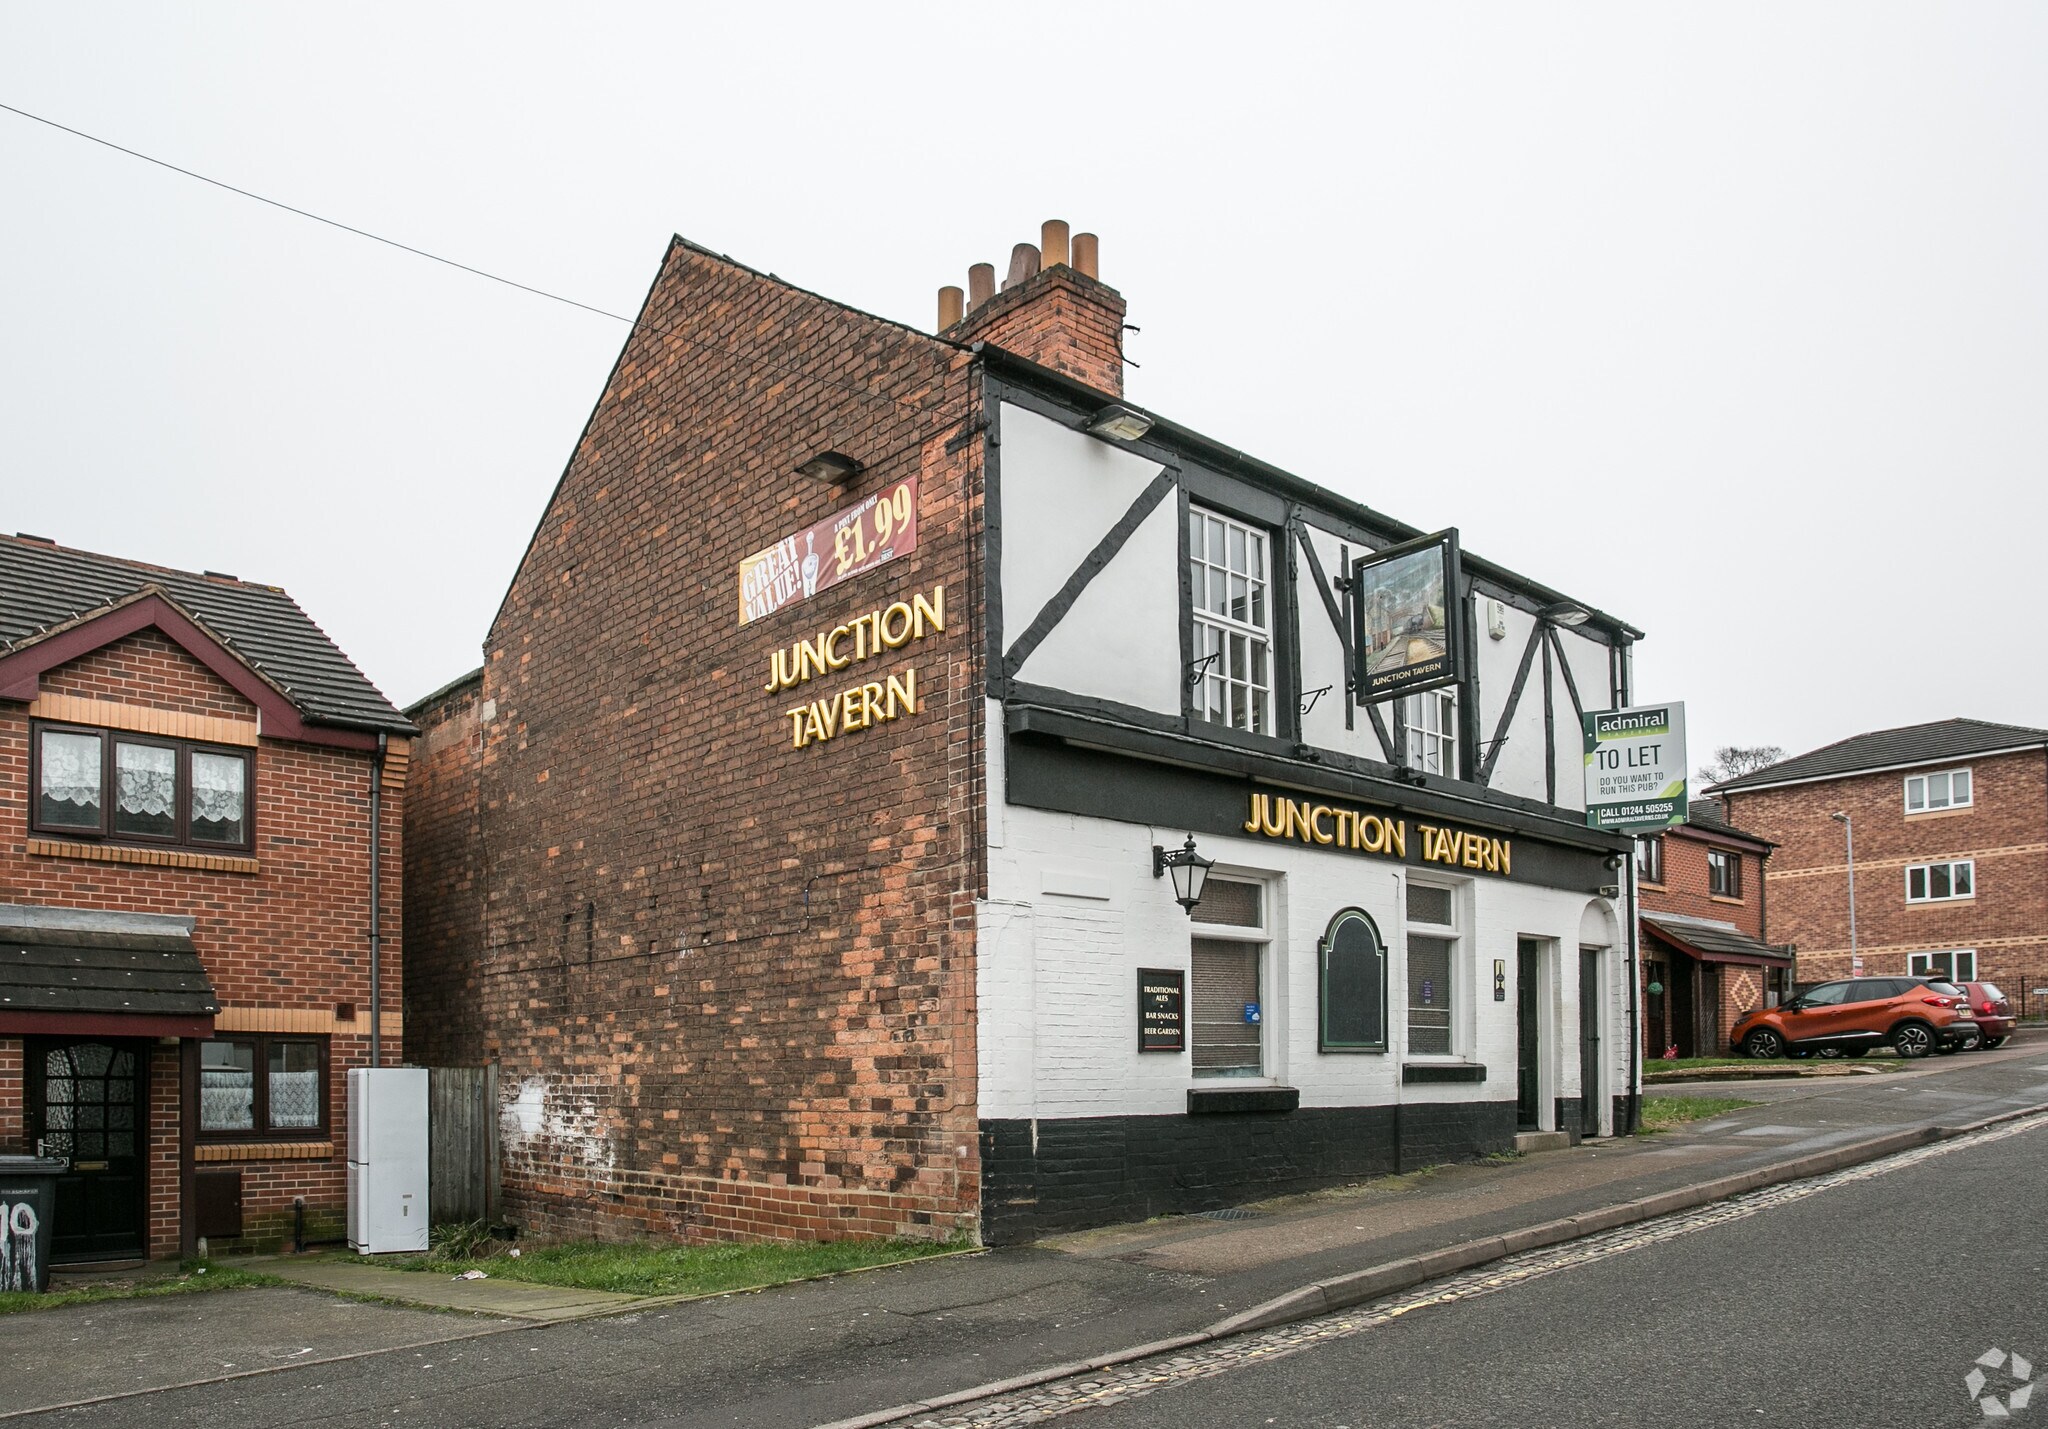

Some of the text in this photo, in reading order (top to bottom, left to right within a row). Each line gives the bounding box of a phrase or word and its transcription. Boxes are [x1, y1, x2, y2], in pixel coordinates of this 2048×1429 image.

[850, 503, 865, 521] FROM
[834, 484, 912, 576] £1.99
[742, 535, 798, 602] GREAT
[746, 560, 802, 621] VALUE!
[765, 585, 945, 692] JUNCTION
[1372, 662, 1441, 686] JUNCTION TAVERN
[786, 669, 917, 748] TAVERN
[1601, 711, 1664, 731] admiral
[1596, 744, 1661, 770] TO LET
[1600, 771, 1664, 786] DO YOU WANT TO
[1600, 781, 1658, 795] RUN THIS PUB?
[1601, 802, 1673, 818] CALL 01244 505255
[1244, 793, 1511, 875] JUNCTION TAVERN
[1143, 986, 1180, 994] TRADITIONAL
[1157, 1012, 1179, 1020] SNACKS
[1144, 1027, 1180, 1035] BEER GARDEN
